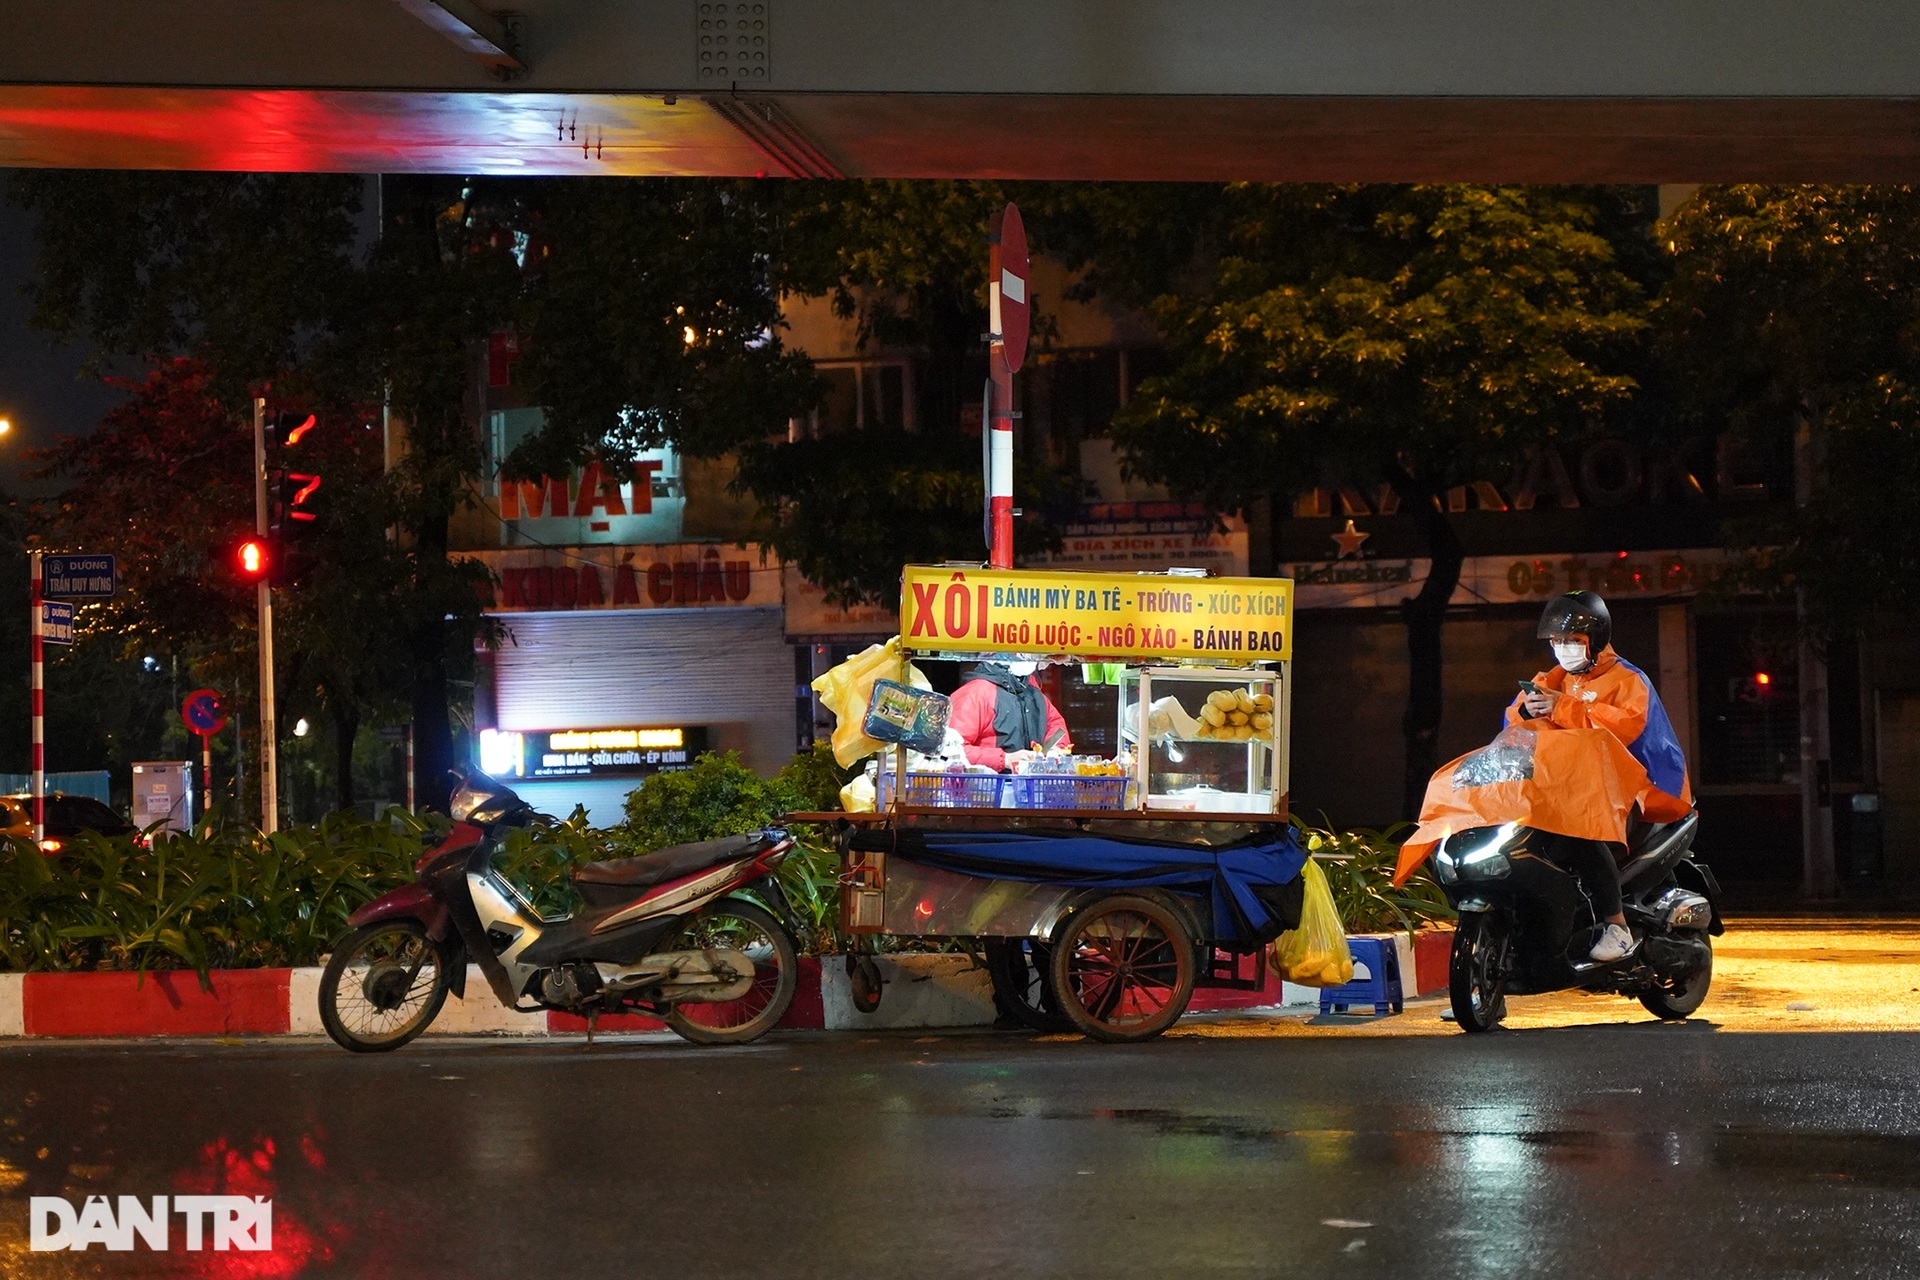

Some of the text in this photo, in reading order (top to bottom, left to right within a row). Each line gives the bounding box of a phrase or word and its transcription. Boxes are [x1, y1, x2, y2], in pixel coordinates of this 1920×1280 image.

[71, 577, 88, 592] DUY
[503, 564, 604, 607] KHOA
[613, 552, 640, 605] Á
[647, 549, 750, 605] CHÂU
[909, 572, 989, 639] XÔI
[993, 583, 1040, 609] BÁNH
[1045, 584, 1070, 610] MỲ
[1075, 589, 1098, 611] BA
[1102, 586, 1121, 612] TÊ
[1137, 588, 1193, 613] TRỨNG
[1208, 590, 1241, 616] XÚC
[1246, 591, 1286, 617] XÍCH
[992, 620, 1030, 645] NGÔ
[1035, 621, 1081, 651] LUỘC
[1098, 623, 1135, 648] NGÔ
[1140, 624, 1177, 649] XÀO
[1193, 625, 1242, 651] BÁNH
[1247, 630, 1283, 652] BAO
[647, 749, 660, 764] ÉP
[662, 749, 687, 763] KÍNH
